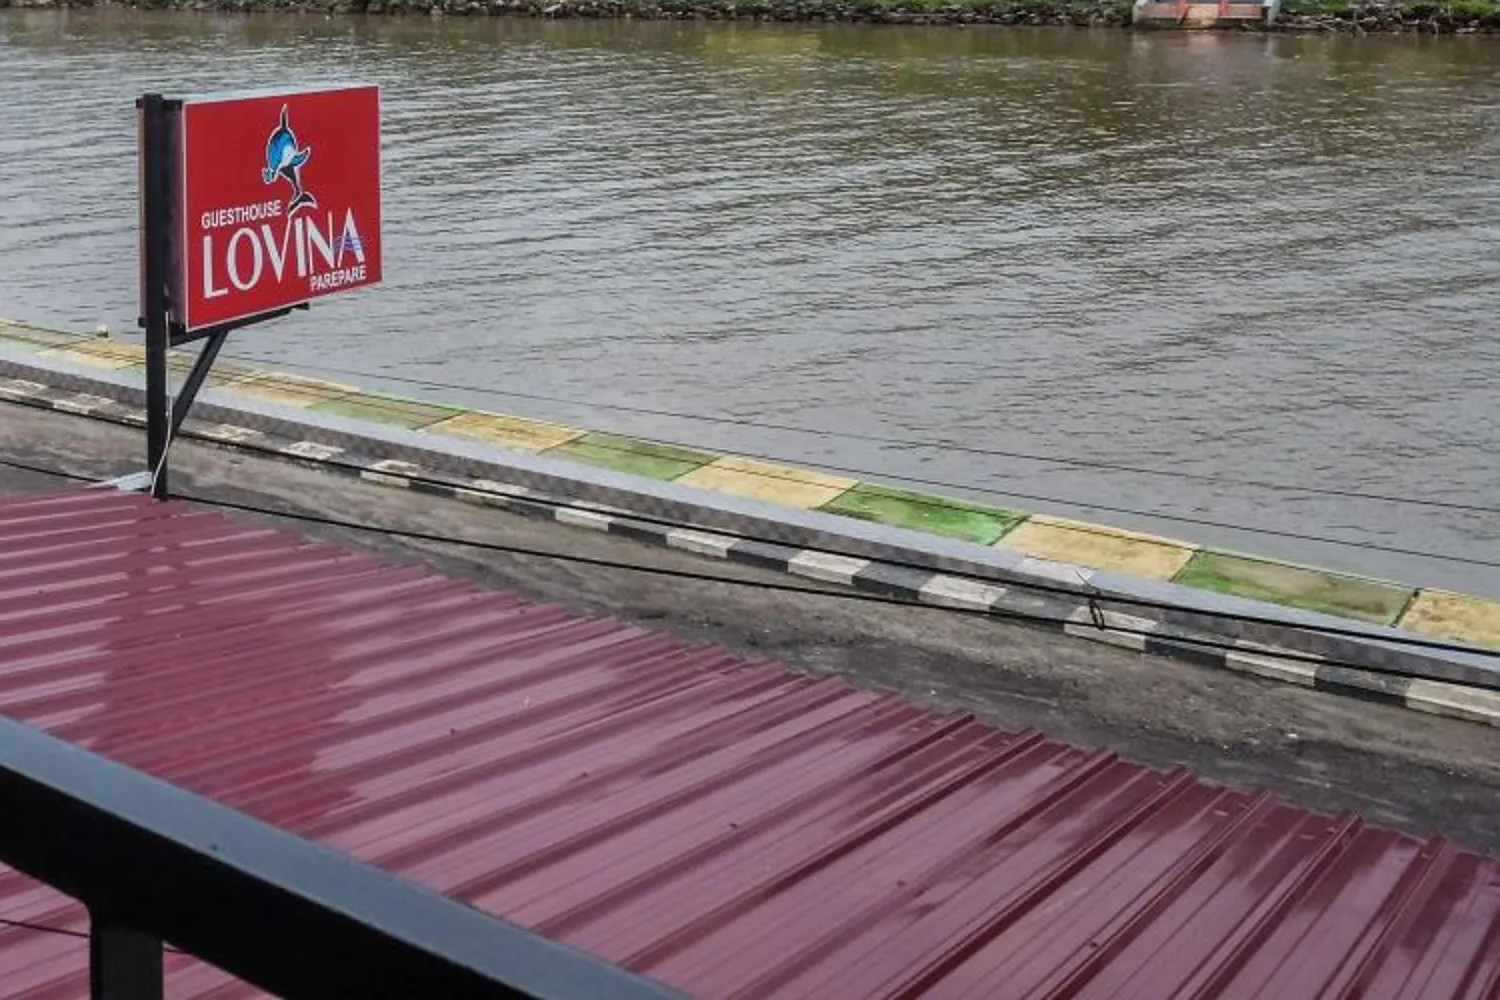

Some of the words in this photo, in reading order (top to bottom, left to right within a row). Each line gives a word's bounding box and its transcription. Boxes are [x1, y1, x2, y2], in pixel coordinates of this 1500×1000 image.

[201, 199, 282, 229] GUESTHOUSE
[203, 207, 365, 299] LOVINA
[309, 264, 367, 293] PAREPARE
